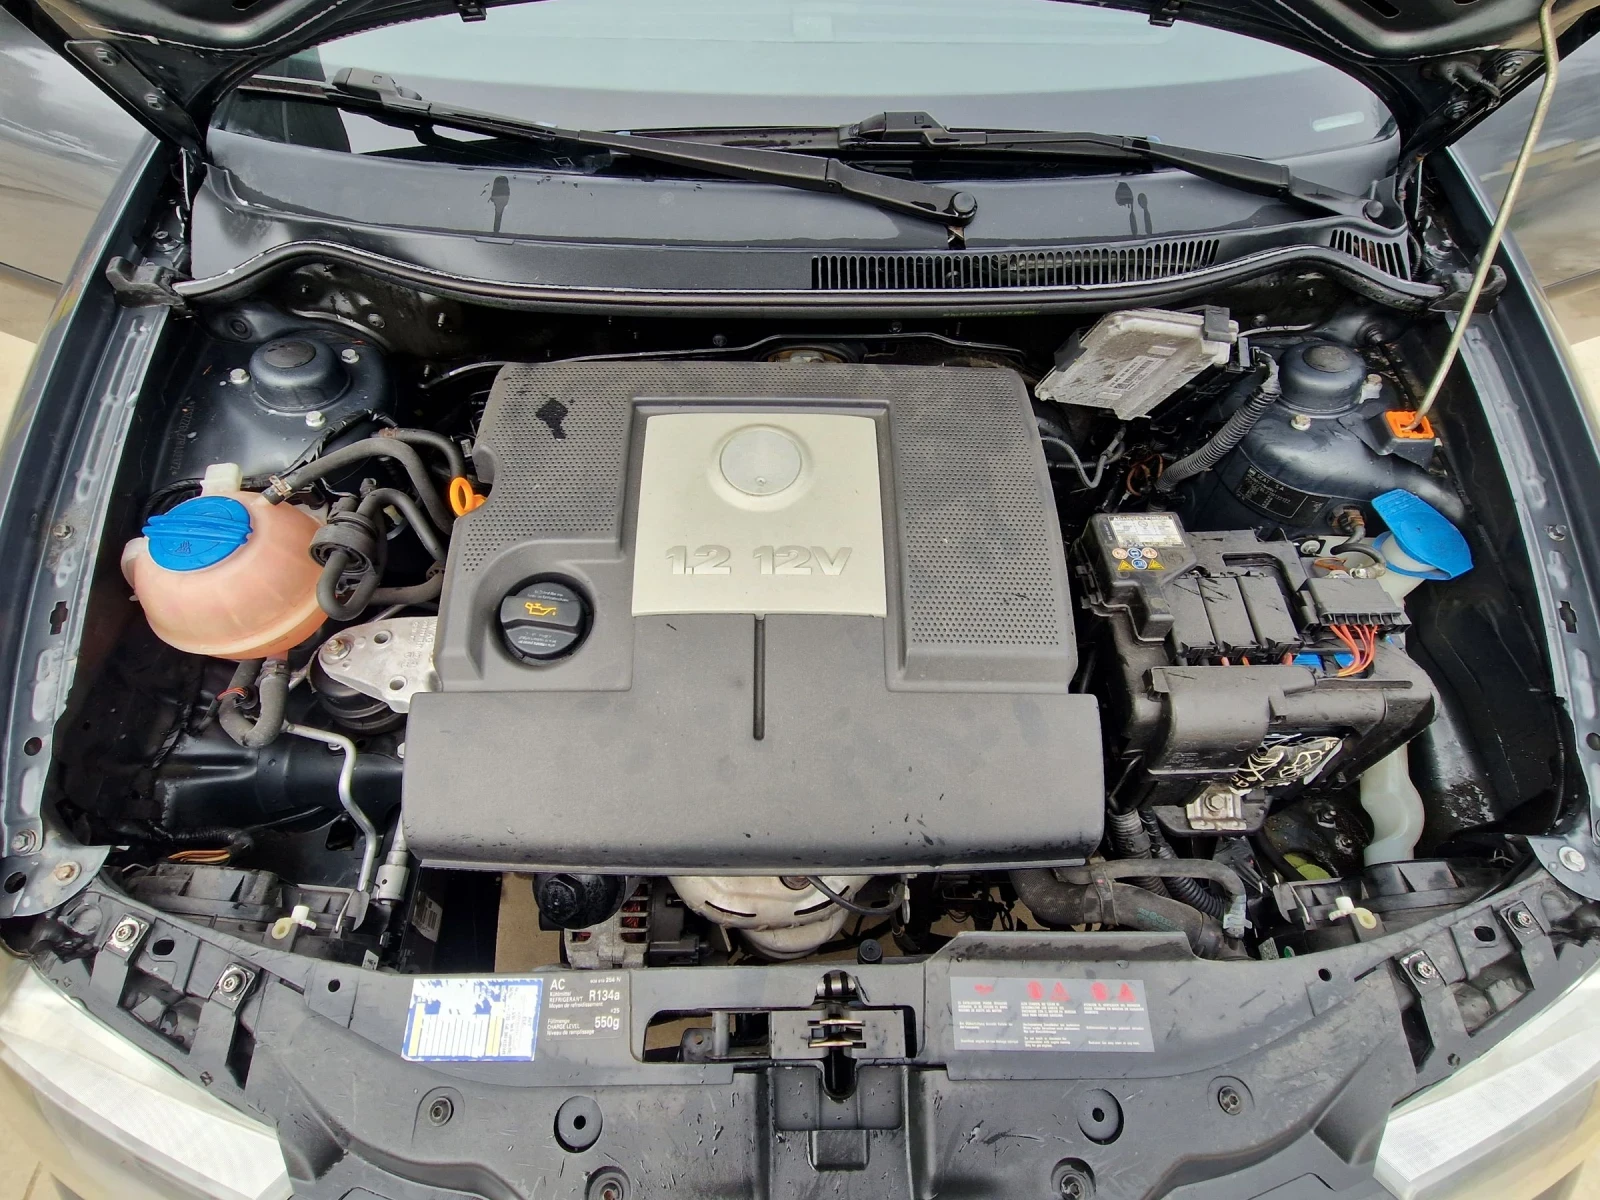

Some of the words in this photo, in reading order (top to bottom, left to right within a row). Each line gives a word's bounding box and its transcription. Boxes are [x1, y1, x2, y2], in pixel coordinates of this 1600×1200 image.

[665, 544, 732, 575] 1.2
[752, 544, 853, 576] 12V
[550, 978, 566, 990] AC
[589, 990, 621, 1001] R134a
[594, 1016, 620, 1030] 550g
